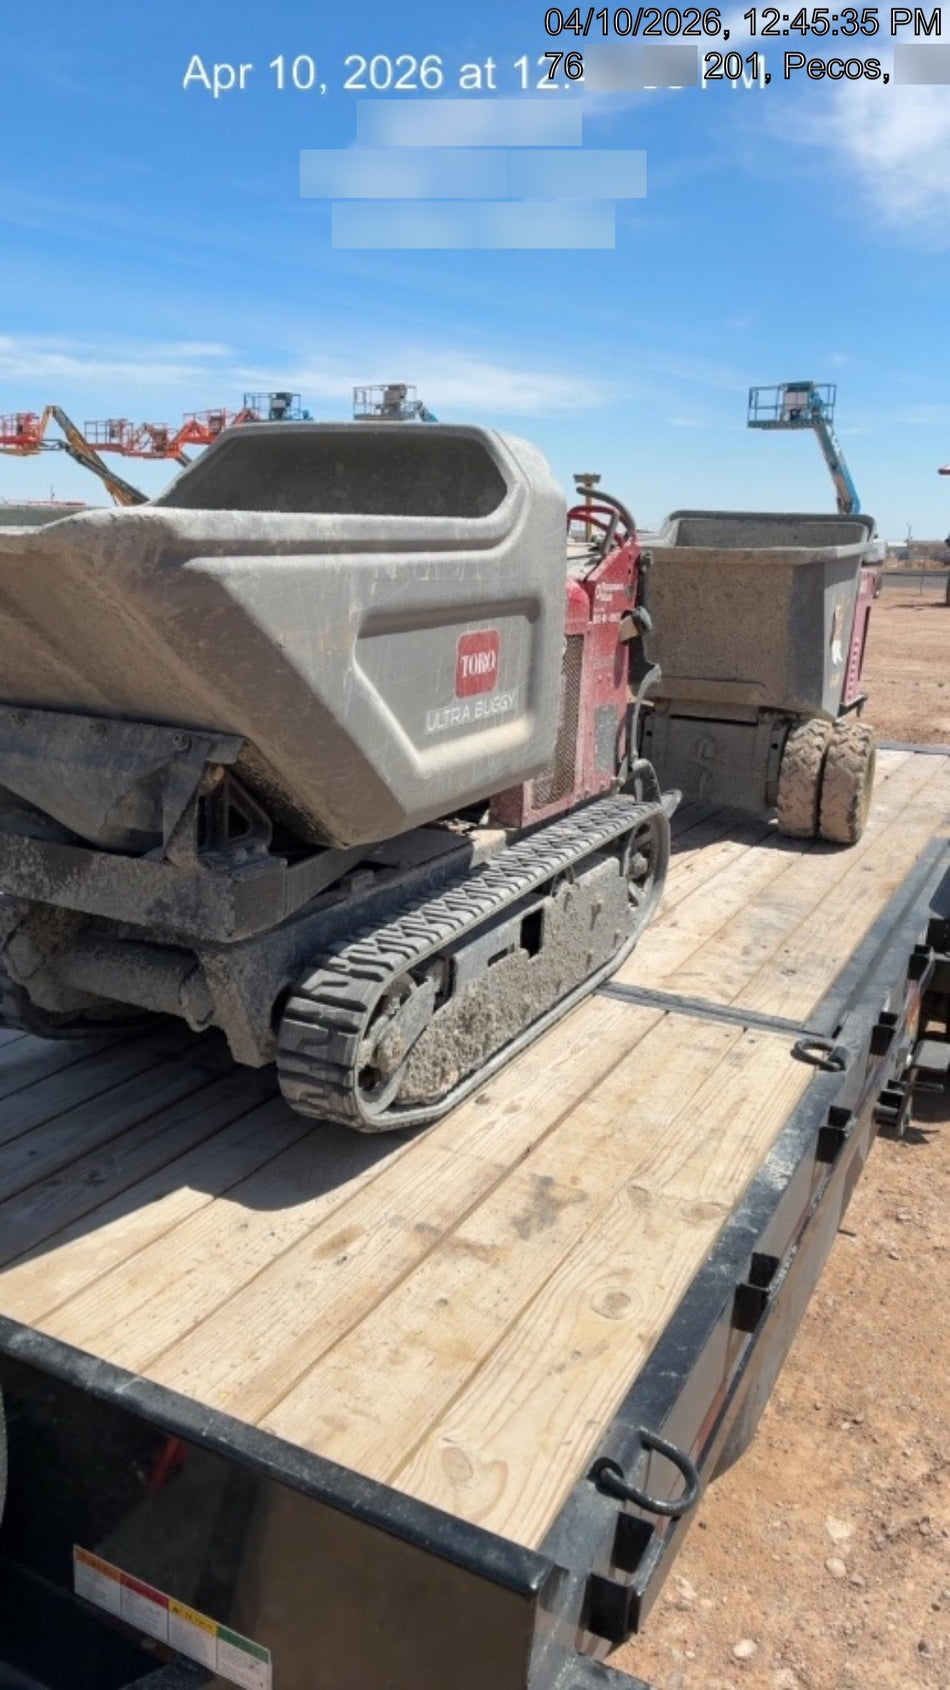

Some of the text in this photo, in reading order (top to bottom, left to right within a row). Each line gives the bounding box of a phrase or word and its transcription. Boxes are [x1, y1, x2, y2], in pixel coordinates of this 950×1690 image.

[461, 650, 496, 677] TORO
[427, 692, 517, 731] ULTRA BUGGY
